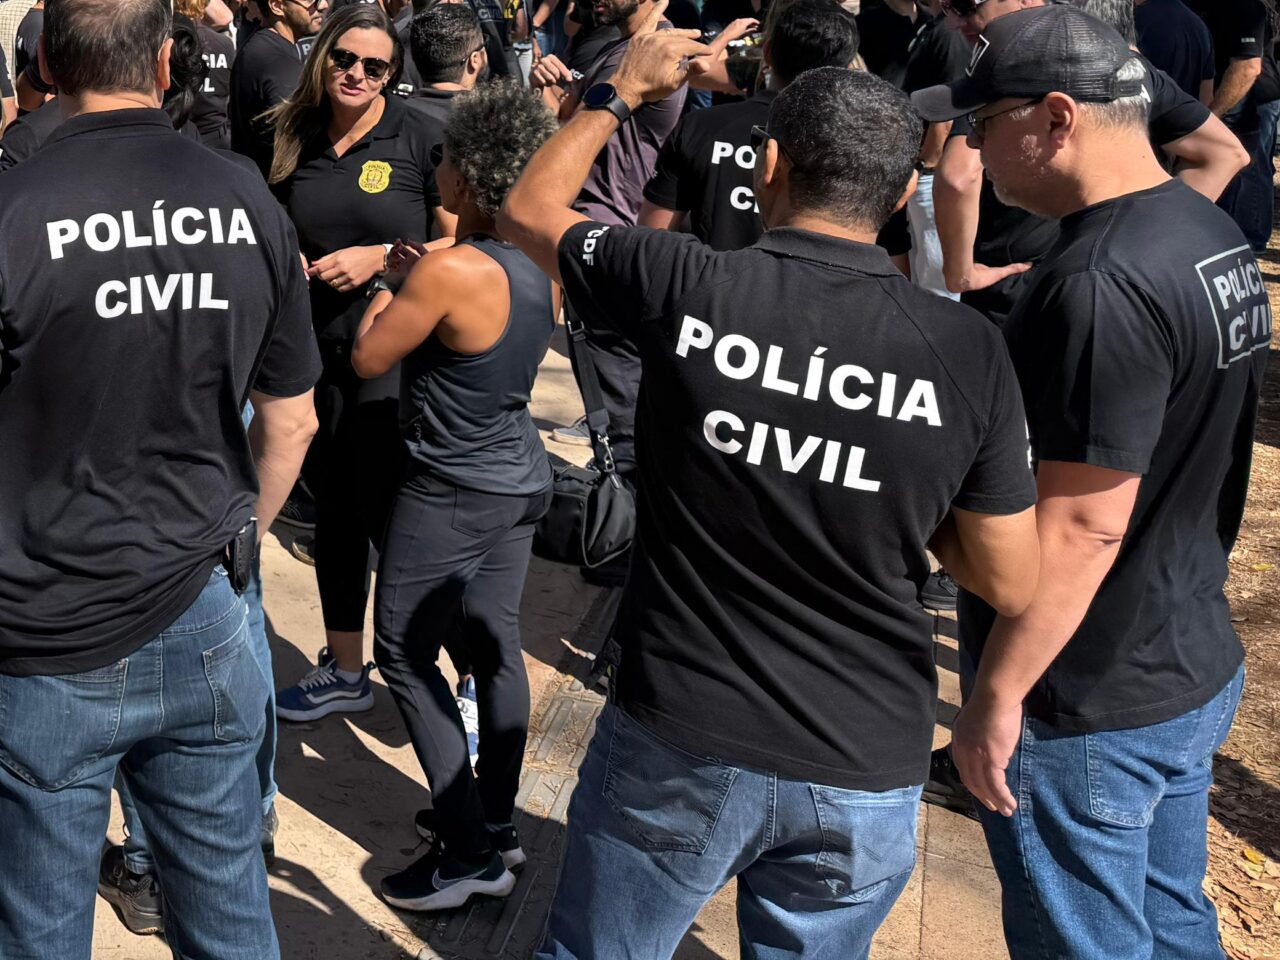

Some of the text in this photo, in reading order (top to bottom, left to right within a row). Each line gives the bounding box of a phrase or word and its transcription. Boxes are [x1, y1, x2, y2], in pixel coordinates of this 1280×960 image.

[46, 200, 257, 260] POLÍCIA
[583, 226, 610, 266] CDF
[95, 272, 230, 319] CIVIL
[1213, 258, 1267, 310] POLÍCI
[675, 315, 943, 428] POLÍCIA
[703, 409, 882, 492] CIVIL
